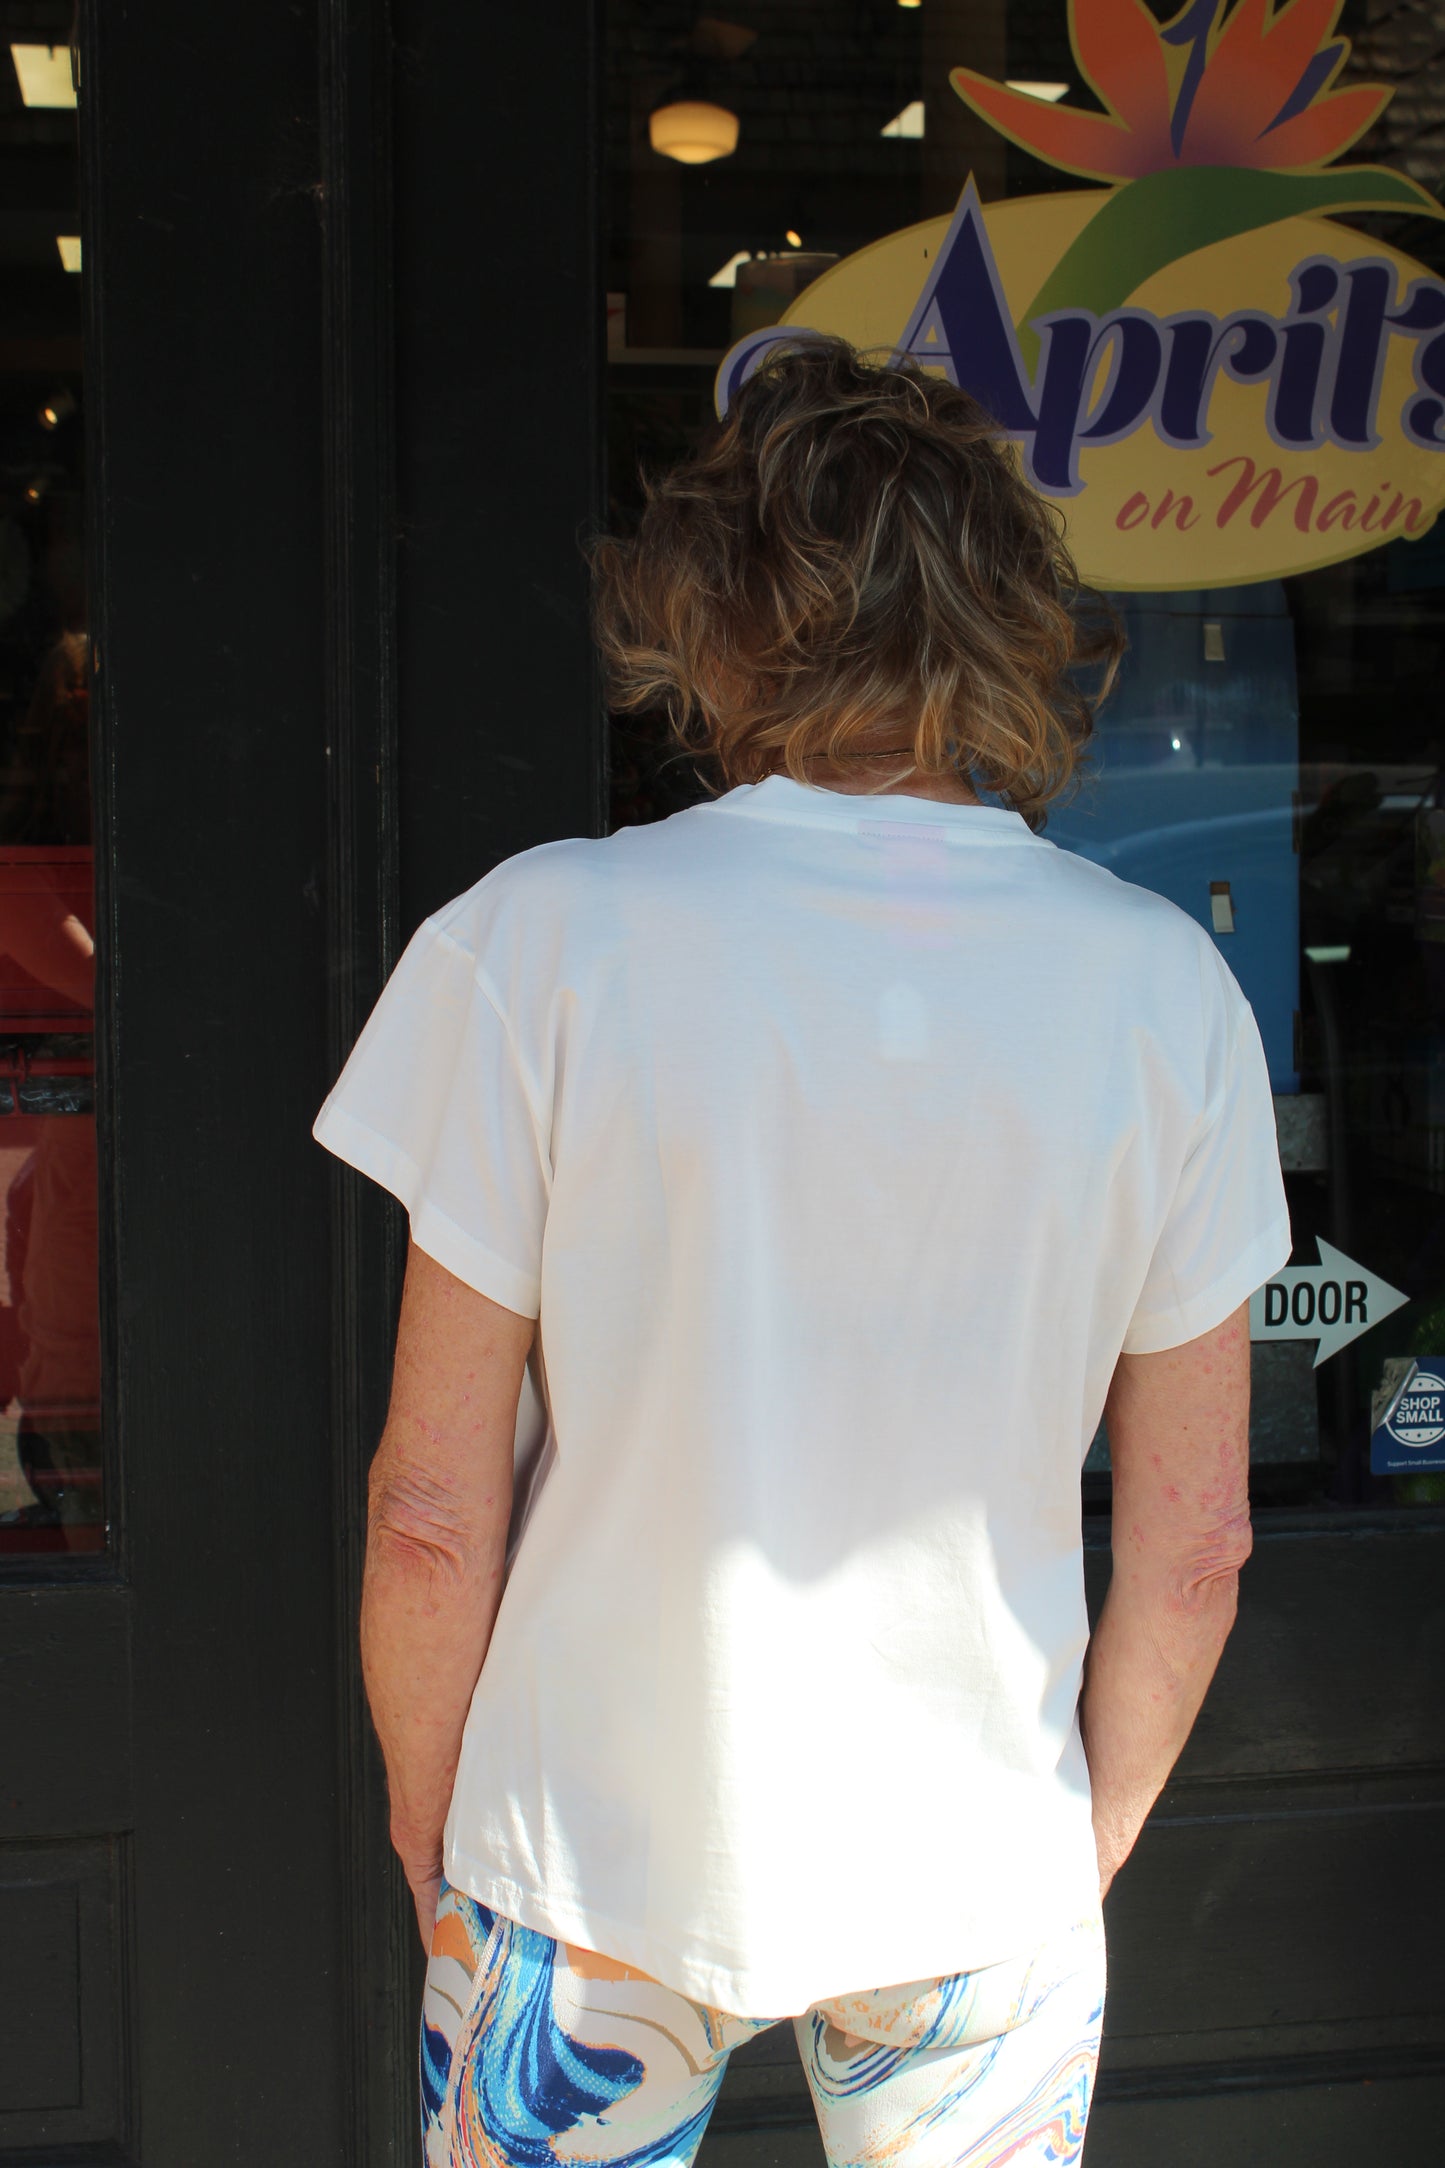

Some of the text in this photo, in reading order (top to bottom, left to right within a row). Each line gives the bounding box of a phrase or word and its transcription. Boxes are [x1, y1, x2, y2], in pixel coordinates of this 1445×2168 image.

[1115, 456, 1431, 534] on Main
[1264, 1280, 1368, 1327] DOOR
[1396, 1409, 1444, 1424] SMALL
[1400, 1397, 1440, 1410] SHOP
